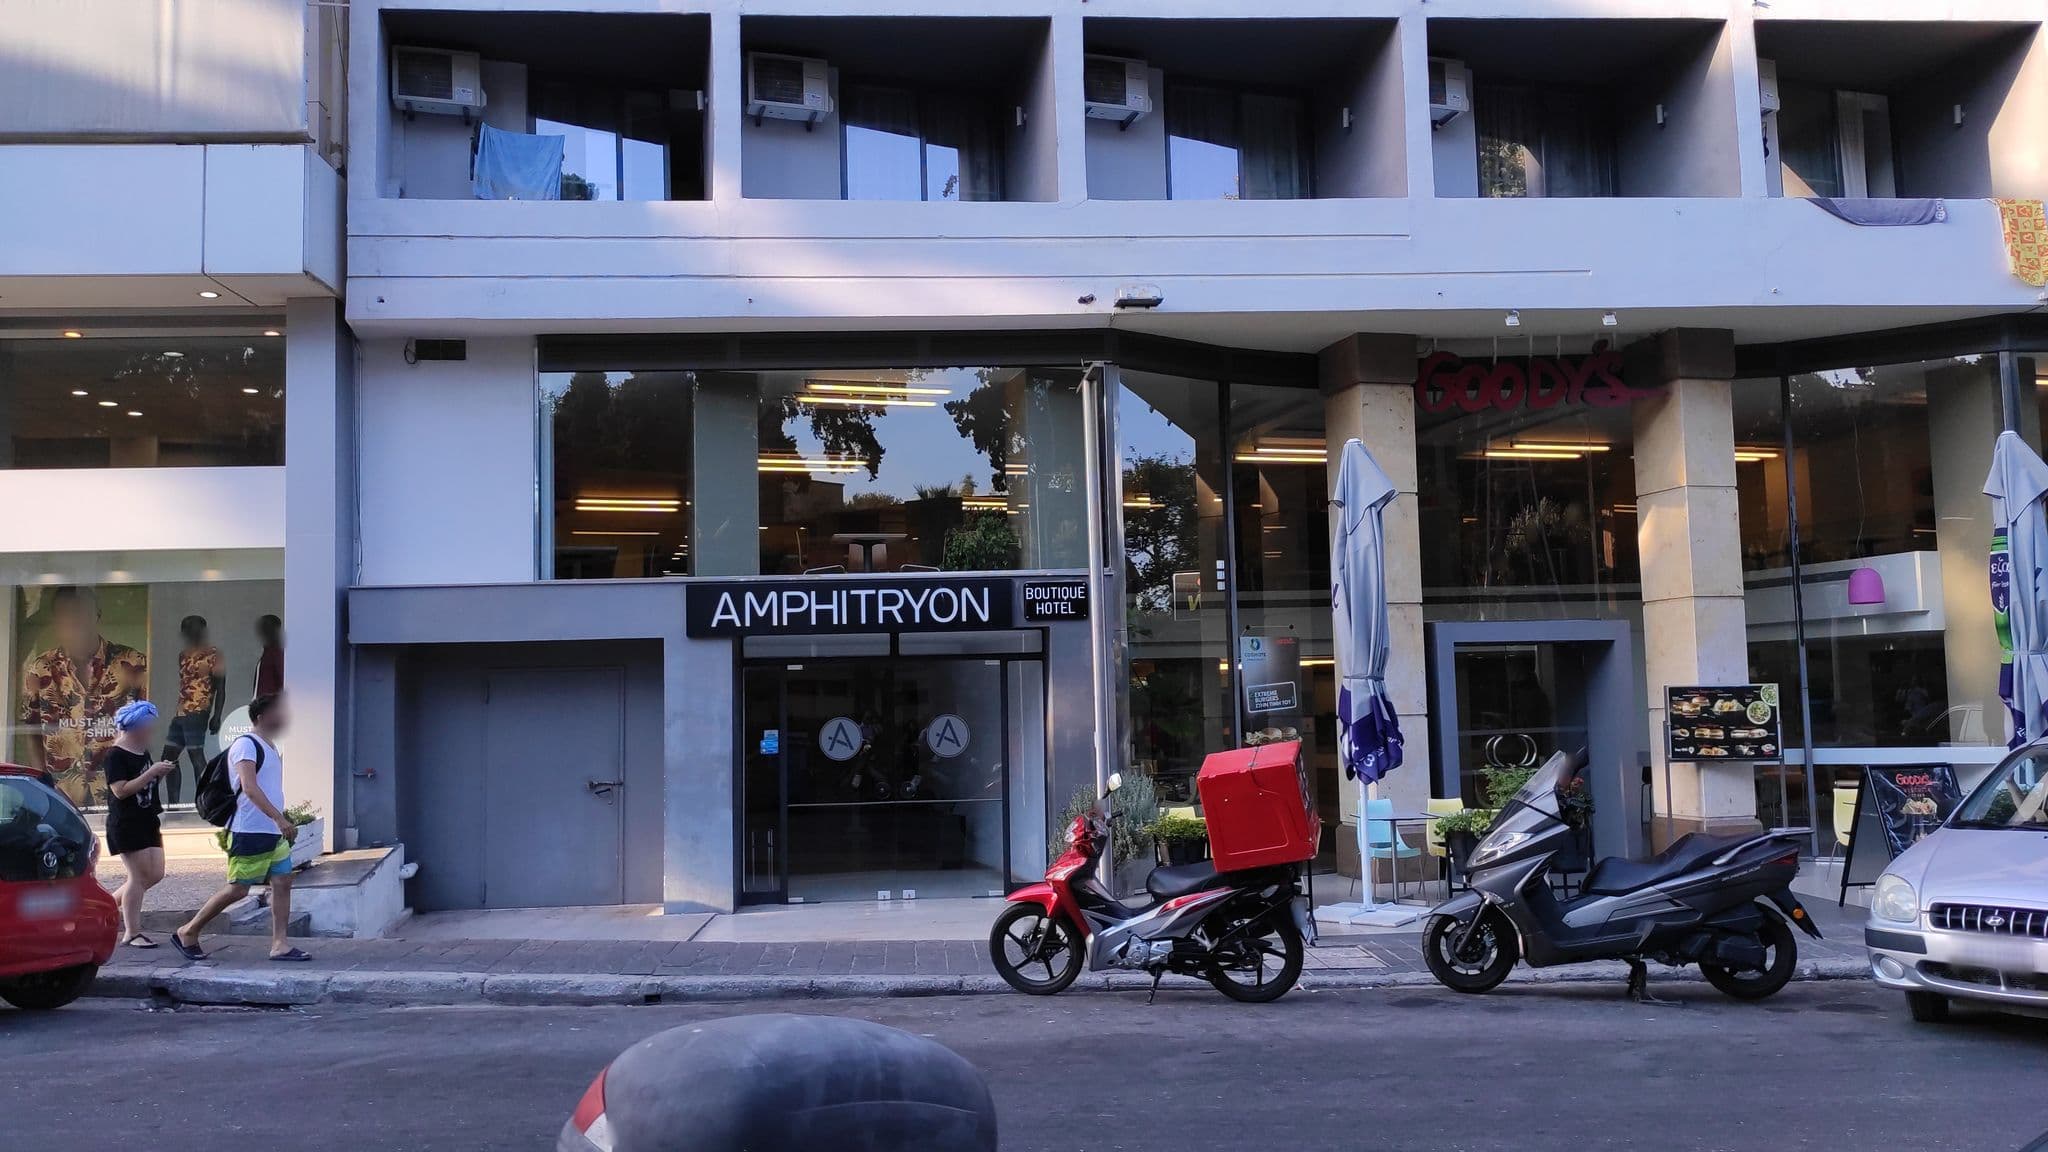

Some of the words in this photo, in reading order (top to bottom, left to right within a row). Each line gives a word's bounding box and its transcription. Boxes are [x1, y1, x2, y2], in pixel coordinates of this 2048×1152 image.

[1025, 586, 1085, 602] BOUTIQUE
[710, 586, 990, 628] AMPHITRYON
[1036, 600, 1076, 616] HOTEL
[1254, 690, 1278, 698] EXTREME
[58, 717, 117, 728] MUST-HA
